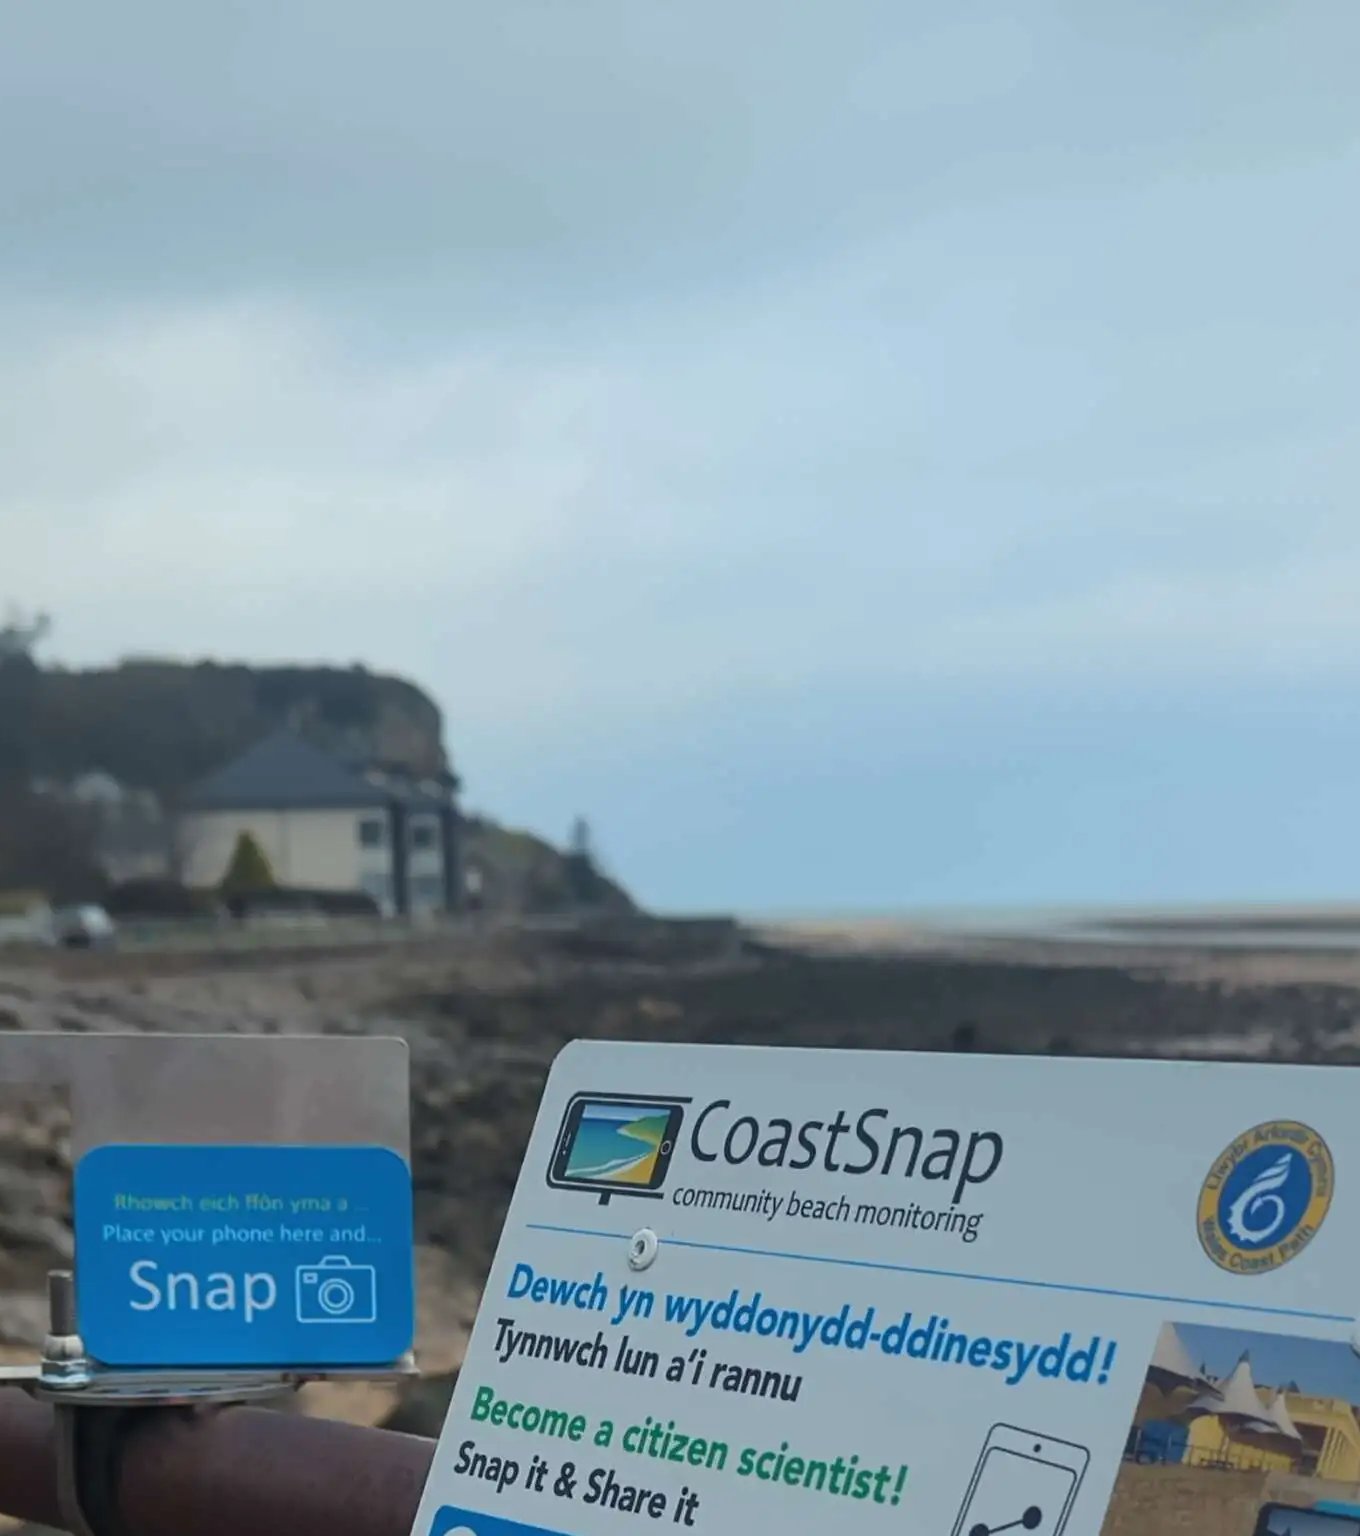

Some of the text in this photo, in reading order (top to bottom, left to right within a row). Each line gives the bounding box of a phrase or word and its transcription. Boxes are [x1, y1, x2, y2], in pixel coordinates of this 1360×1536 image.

[691, 1100, 1003, 1204] CoastSnap
[103, 1224, 155, 1242] Place
[161, 1228, 204, 1245] your
[211, 1224, 274, 1245] phone
[280, 1224, 324, 1242] here
[114, 1193, 192, 1211] Rhowch
[199, 1193, 239, 1211] eich
[291, 1196, 331, 1213] yma
[337, 1196, 348, 1211] a
[673, 1186, 983, 1243] community beach monitoring
[129, 1260, 277, 1323] Snap
[507, 1263, 1117, 1385] Dewch yn wyddonydd-ddinesydd!
[494, 1317, 608, 1368] Tynnwch
[613, 1335, 659, 1378] lun
[709, 1362, 803, 1402] rannu
[453, 1440, 700, 1527] Snap it & Share it
[470, 1386, 909, 1506] Become a citizen scientist!
